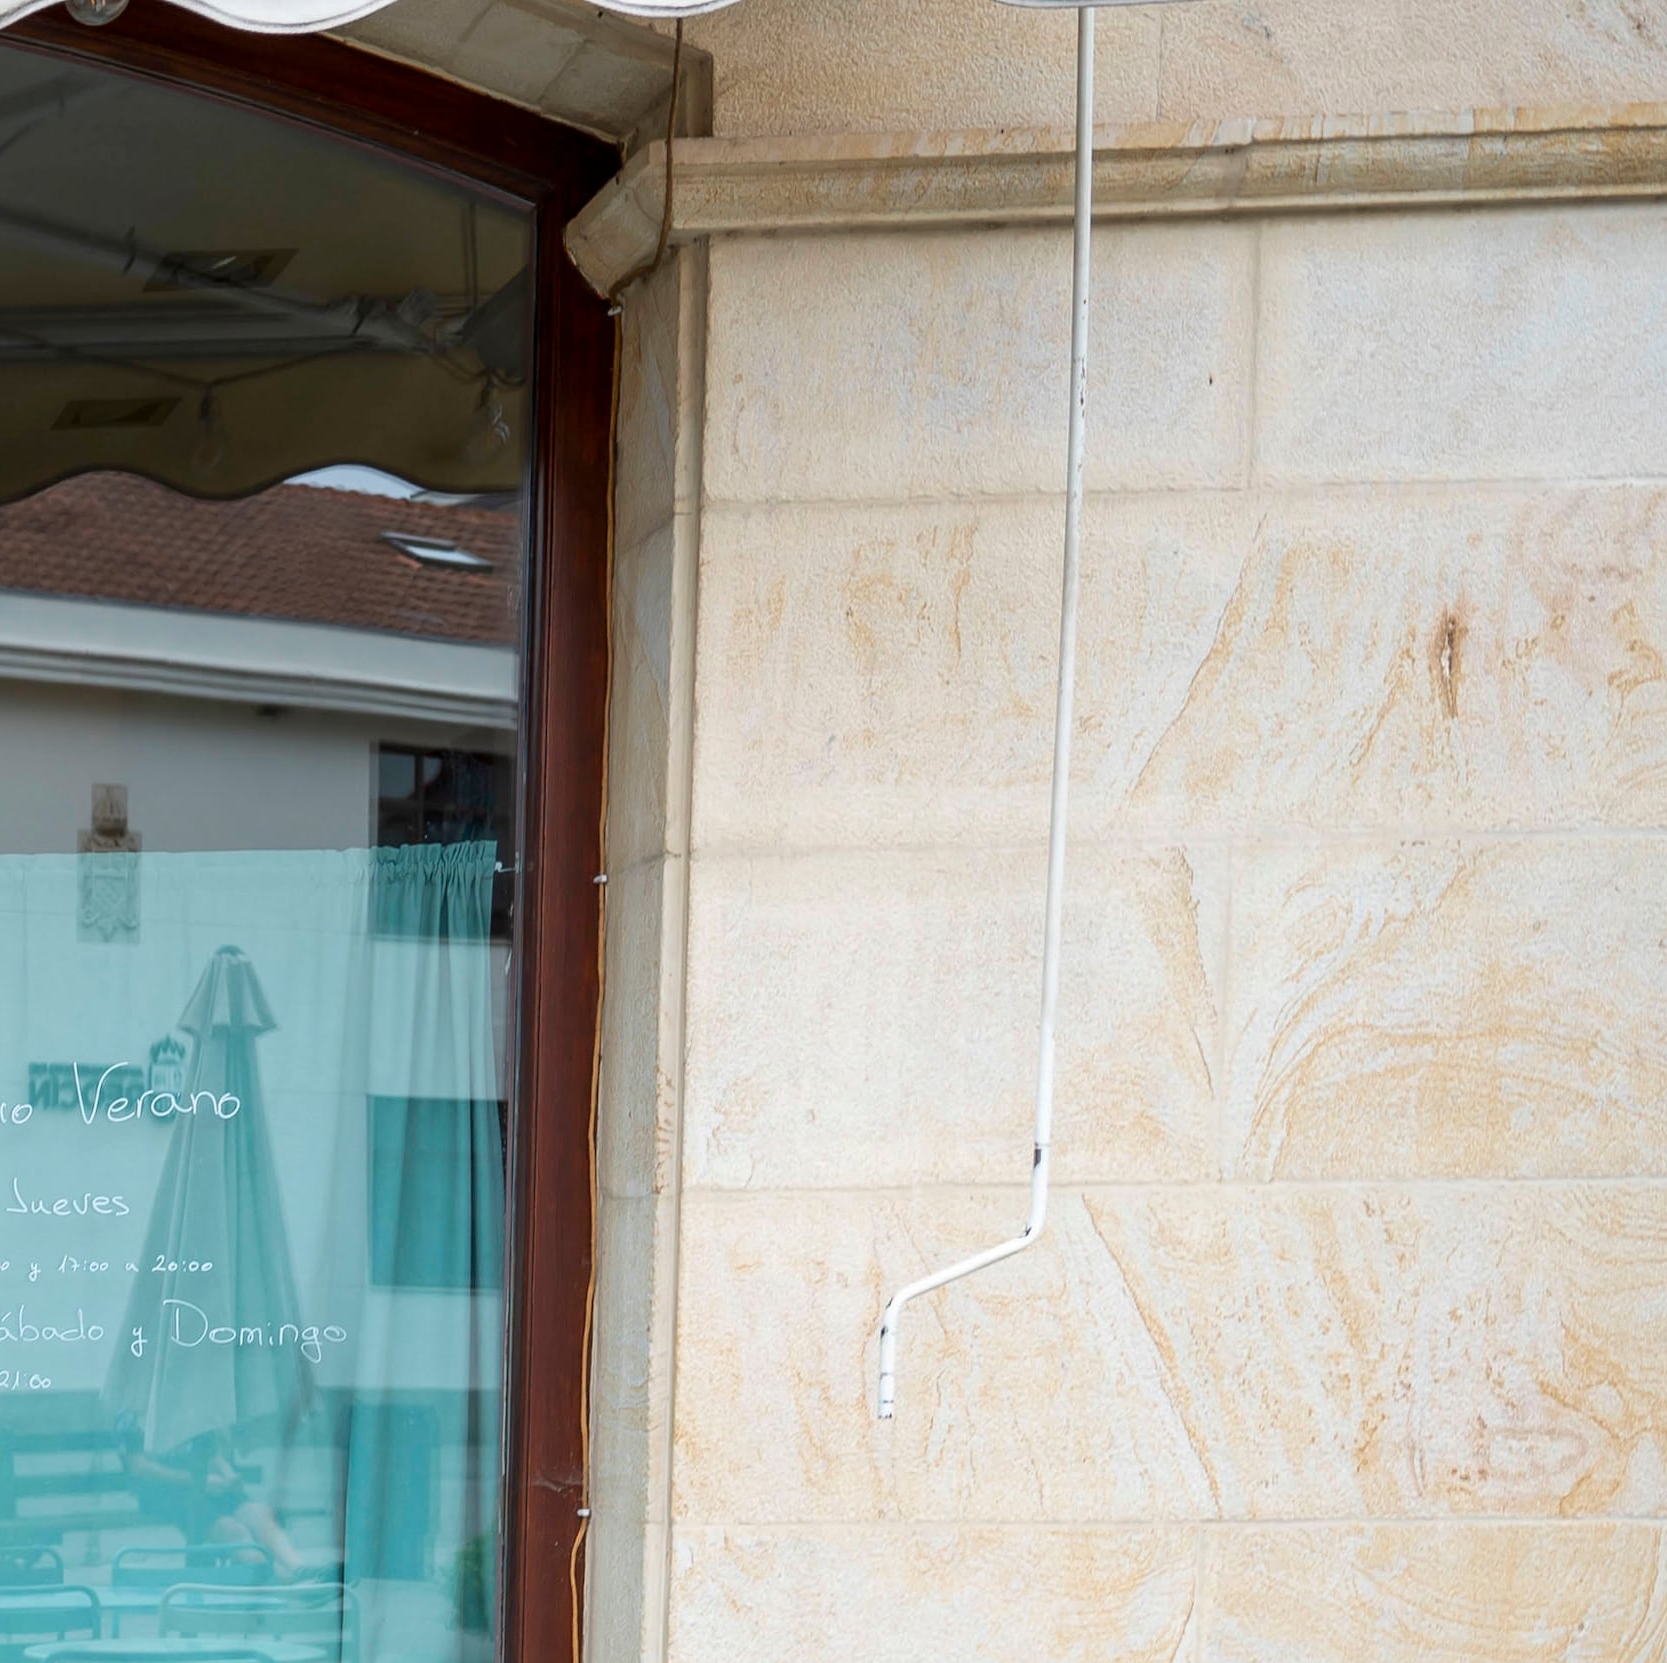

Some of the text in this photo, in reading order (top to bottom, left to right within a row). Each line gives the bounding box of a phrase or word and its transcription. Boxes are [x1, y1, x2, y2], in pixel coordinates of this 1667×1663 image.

[73, 1060, 240, 1124] Verano
[6, 1177, 130, 1216] Jueves
[28, 1260, 41, 1282] y
[58, 1254, 109, 1273] 17:00
[125, 1261, 139, 1272] a
[152, 1254, 213, 1273] 20:00
[131, 1325, 148, 1358] y
[162, 1299, 347, 1362] Domingo
